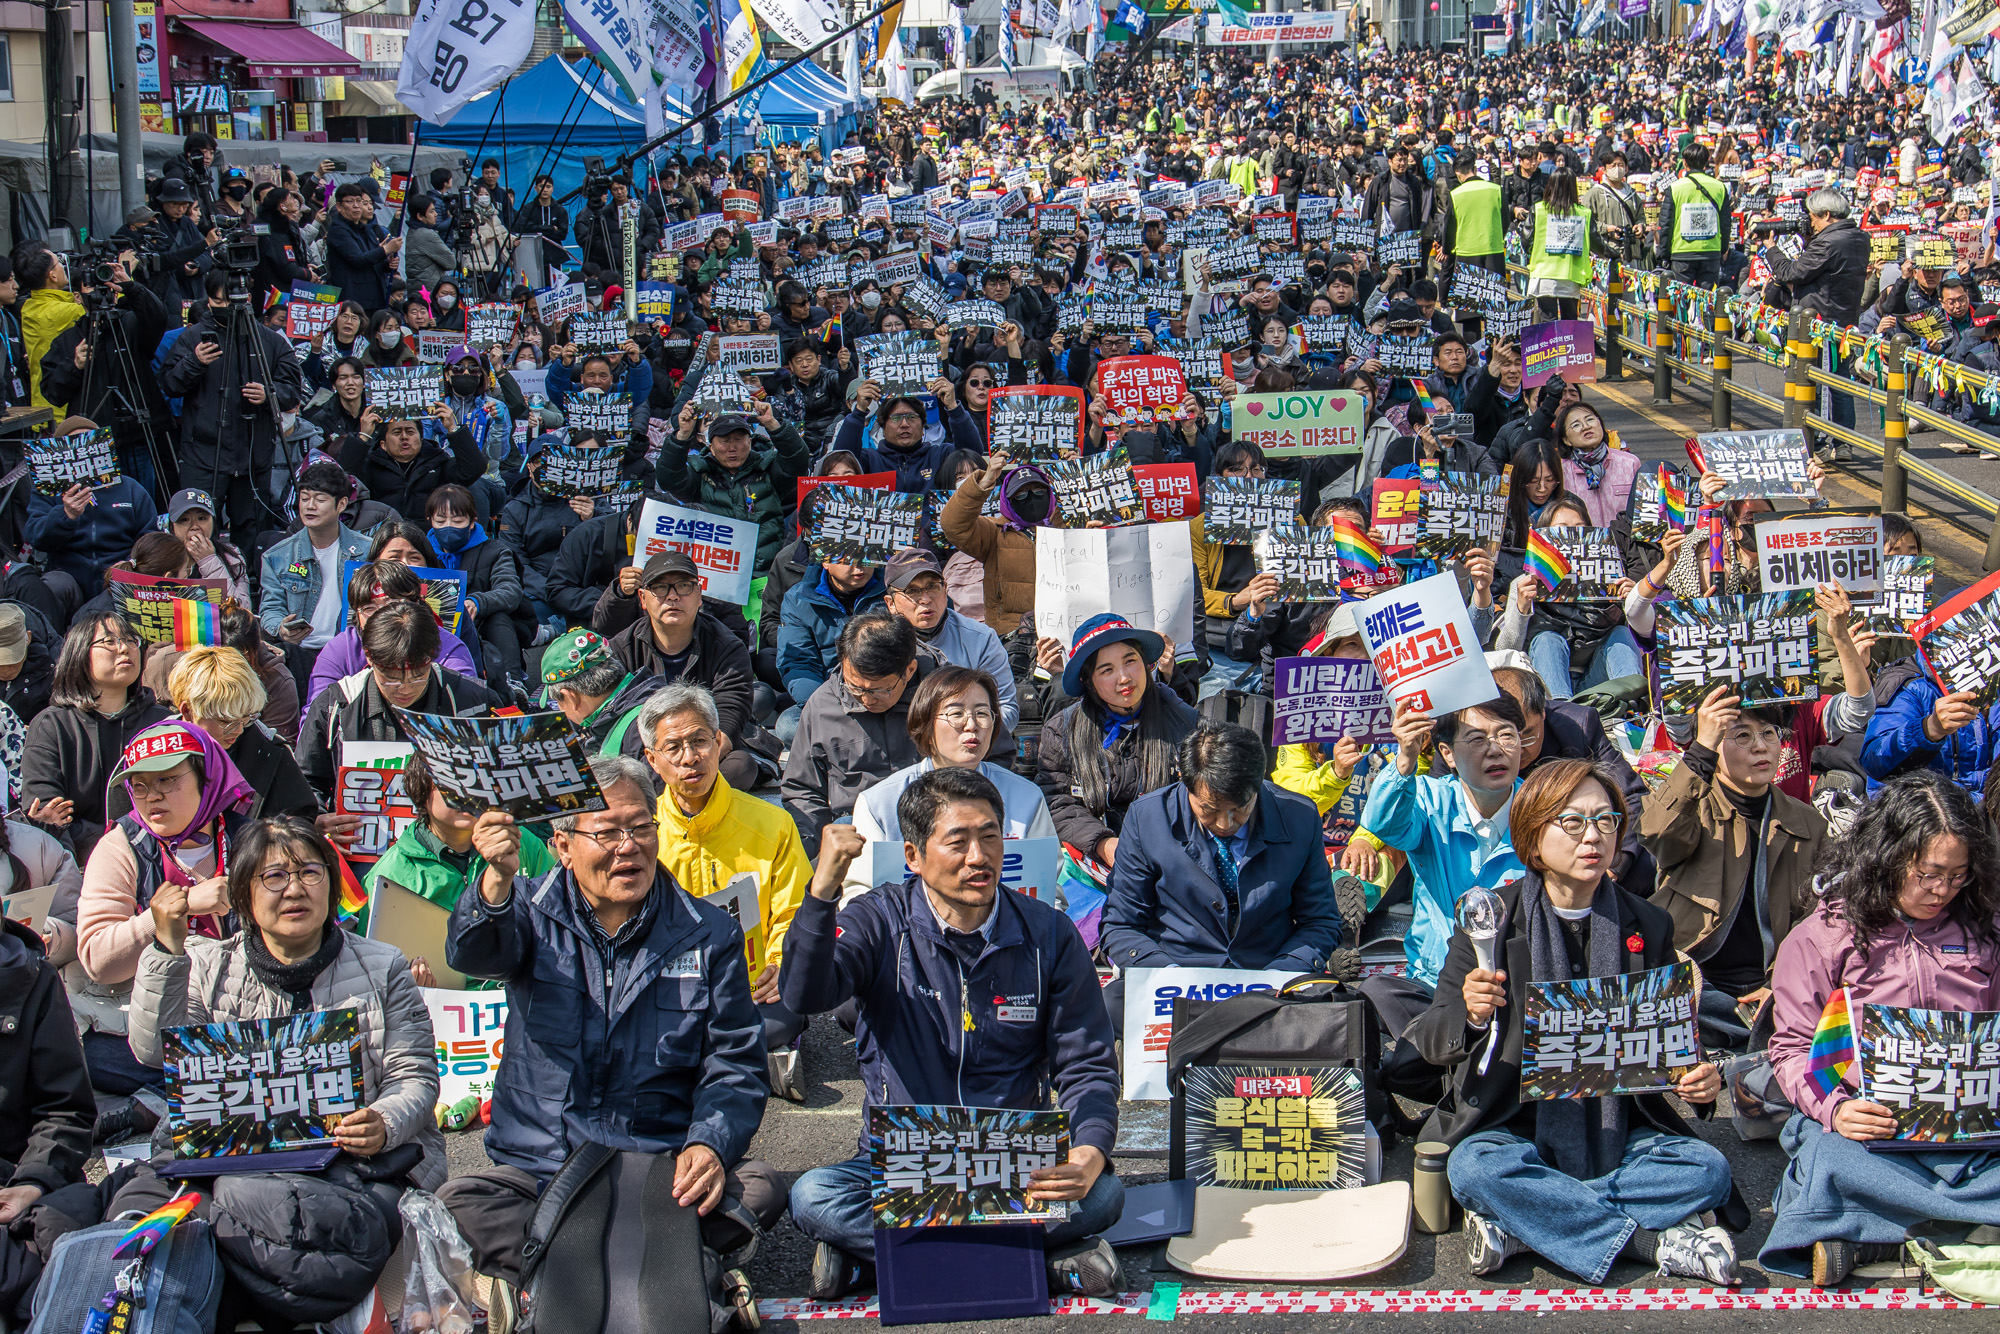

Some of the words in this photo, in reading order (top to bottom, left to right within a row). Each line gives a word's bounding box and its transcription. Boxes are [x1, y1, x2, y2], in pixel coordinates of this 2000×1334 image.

[1221, 29, 1277, 42] 내란세력
[1279, 26, 1334, 41] 완전청산!
[1039, 220, 1075, 231] 즉각파면
[1257, 229, 1292, 240] 즉각파면
[1335, 233, 1375, 248] 즉각파면
[991, 251, 1033, 264] 즉각파면
[1209, 254, 1261, 274] 즉각파면
[1379, 248, 1420, 264] 즉각파면
[878, 263, 919, 283] 해체하라
[1454, 283, 1506, 302] 즉각파면
[715, 299, 764, 312] 즉각파면
[1093, 304, 1123, 312] 내란수괴
[1123, 304, 1146, 312] 윤석열
[573, 322, 600, 332] 내란수괴
[602, 319, 627, 331] 윤석열
[1093, 312, 1146, 327] 즉각파면
[573, 330, 628, 346] 즉각파면
[723, 350, 779, 367] 해체하라
[1380, 344, 1409, 355] 내란수괴
[1411, 346, 1433, 355] 윤석열
[1525, 344, 1576, 366] 페미니스트가
[1379, 354, 1433, 371] 즉각파면
[1526, 356, 1567, 377] 민주주의를
[1568, 352, 1593, 366] 구한다
[370, 380, 409, 391] 내란수괴
[411, 377, 439, 390] 윤석열
[869, 363, 941, 386] 즉각파면
[1102, 366, 1151, 388] 윤석열
[1152, 366, 1182, 384] 파면
[371, 389, 440, 409] 즉각파면
[1111, 387, 1144, 407] 빛의
[1145, 384, 1178, 403] 혁명
[567, 404, 600, 415] 내란수괴
[603, 403, 629, 414] 윤석열
[995, 411, 1039, 424] 내란수괴
[1041, 411, 1074, 425] 윤석열
[1267, 395, 1325, 421] JOY
[568, 413, 630, 430] 즉각파면
[995, 426, 1075, 449] 즉각파면
[1241, 430, 1297, 449] 대청소
[1303, 425, 1357, 447] 마쳤다
[31, 447, 75, 464] 내란수괴
[76, 441, 111, 459] 윤석열
[546, 455, 589, 470] 내란수괴
[590, 456, 619, 470] 윤석열
[1711, 450, 1762, 464] 내란수괴
[1765, 447, 1802, 461] 윤석열
[35, 454, 115, 482] 즉각파면
[546, 465, 619, 489] 즉각파면
[1715, 460, 1807, 484] 즉각파면
[1053, 475, 1088, 493] 내란수괴
[1089, 468, 1128, 488] 윤석열
[1157, 477, 1191, 496] 파면
[1061, 481, 1136, 517] 즉각파면
[1151, 496, 1184, 518] 혁명
[1212, 492, 1258, 506] 내란수괴
[1260, 494, 1294, 509] 윤석열
[1428, 491, 1482, 508] 내란수괴
[1483, 494, 1506, 513] 윤석열
[824, 501, 877, 522] 내란수괴
[880, 508, 917, 525] 윤석열
[1211, 505, 1294, 530] 즉각파면
[655, 515, 734, 546] 윤석열은
[820, 516, 914, 550] 즉각파면
[1427, 509, 1504, 541] 즉각파면
[1264, 543, 1311, 558] 내란수괴
[1588, 544, 1620, 558] 윤석열
[1766, 531, 1824, 550] 내란동조
[1040, 530, 1095, 576] Appeal
[288, 563, 309, 577] 파면
[1767, 548, 1881, 587] 해체하라
[1039, 573, 1081, 593] American
[1884, 575, 1926, 592] 윤석열
[1039, 613, 1082, 630] PEACE
[1365, 601, 1426, 649] 헌재는
[1668, 620, 1748, 648] 내란수괴
[1752, 615, 1809, 639] 윤석열
[1669, 639, 1812, 686] 즉각파면
[1287, 663, 1382, 695] 내란세
[124, 741, 149, 768] 석열
[151, 733, 184, 753] 퇴진
[498, 741, 571, 762] 윤석열
[426, 759, 588, 806] 즉각파면
[1539, 1004, 1630, 1034] 내란수괴
[1637, 992, 1692, 1027] 윤석열
[1534, 1025, 1698, 1073] 즉각파면
[1875, 1036, 1973, 1065] 내란수괴
[179, 1052, 276, 1082] 내란수괴
[280, 1040, 352, 1072] 윤석열
[1243, 1079, 1302, 1096] 내란수괴
[181, 1071, 356, 1127] 즉각파면
[1216, 1097, 1338, 1128] 윤석열을
[884, 1131, 980, 1152] 내란수괴
[986, 1131, 1058, 1152] 윤석열
[884, 1152, 1054, 1195] 즉각파면
[1216, 1151, 1338, 1181] 파면하라
